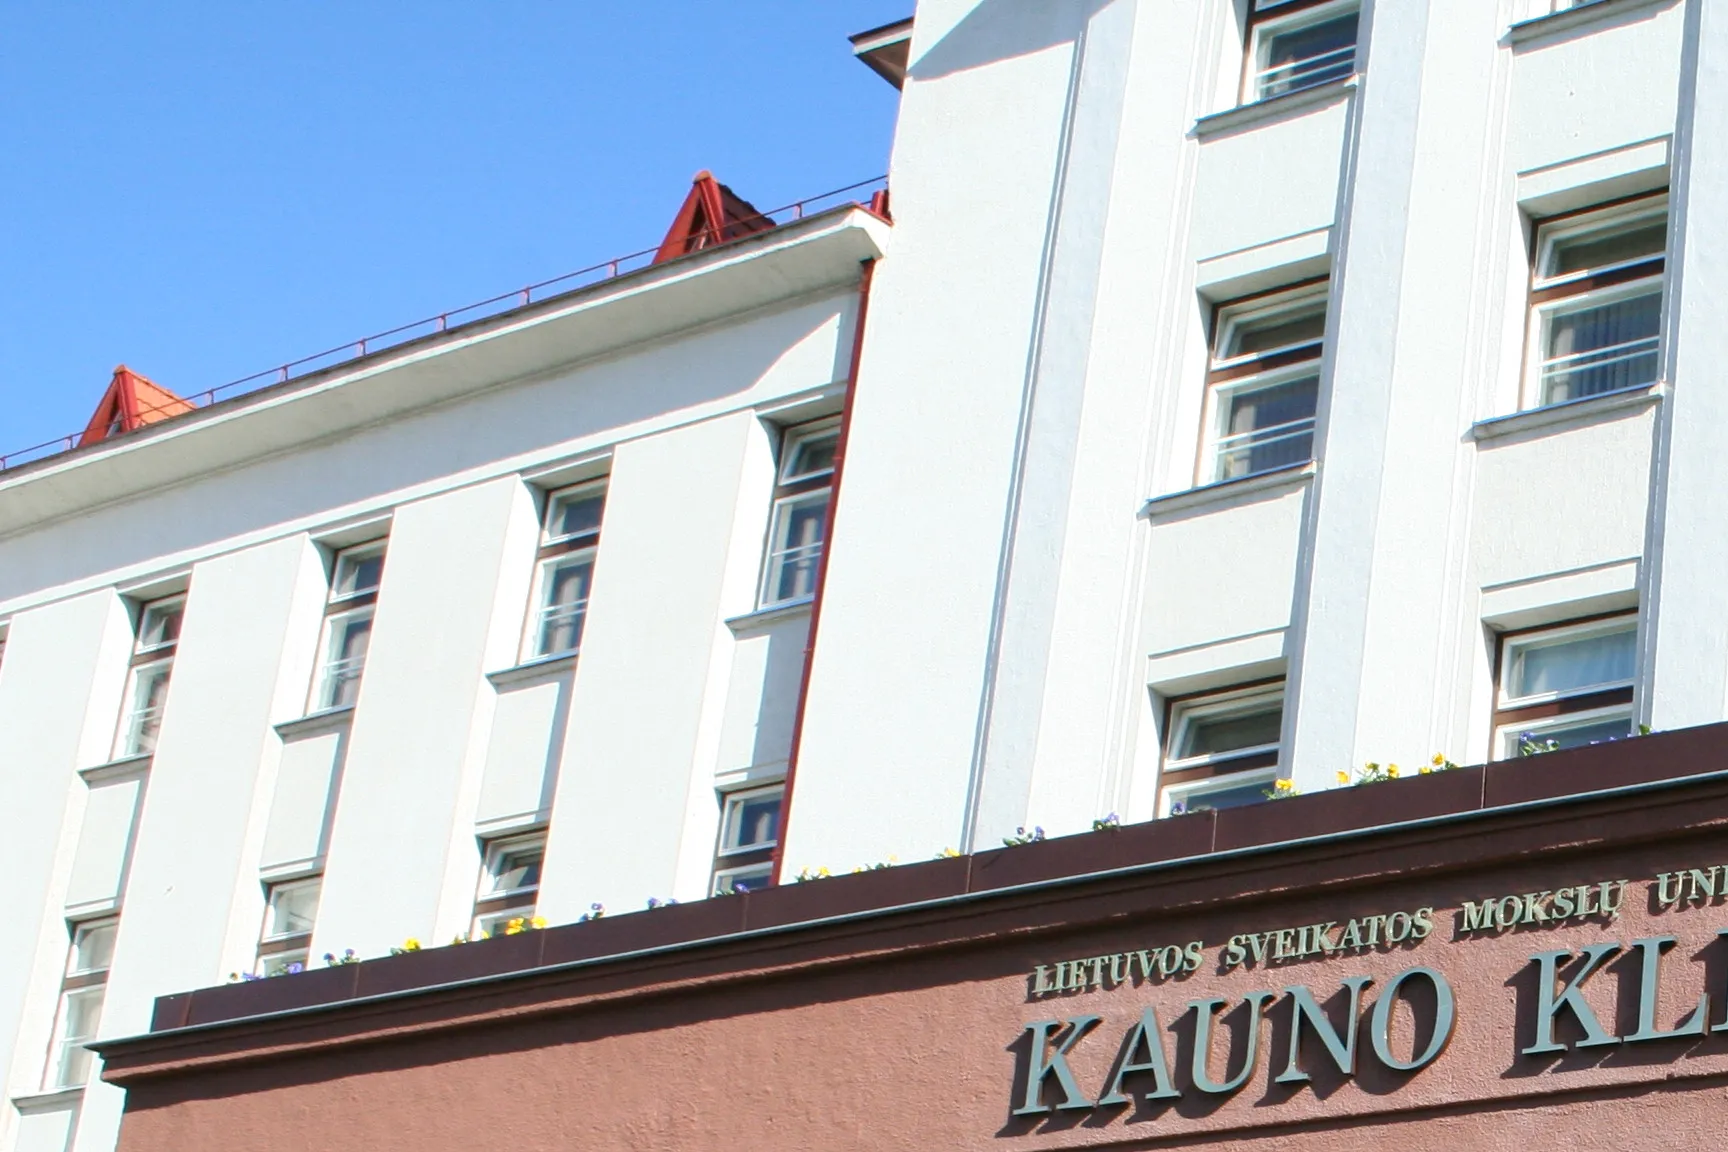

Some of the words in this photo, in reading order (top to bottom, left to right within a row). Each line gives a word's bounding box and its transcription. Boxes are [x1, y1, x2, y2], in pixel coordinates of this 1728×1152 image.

[1033, 941, 1203, 995] LIETUVOS
[1225, 906, 1434, 967] SVEIKATOS
[1460, 879, 1627, 932] MOKSLŲ
[1012, 966, 1457, 1117] KAUNO
